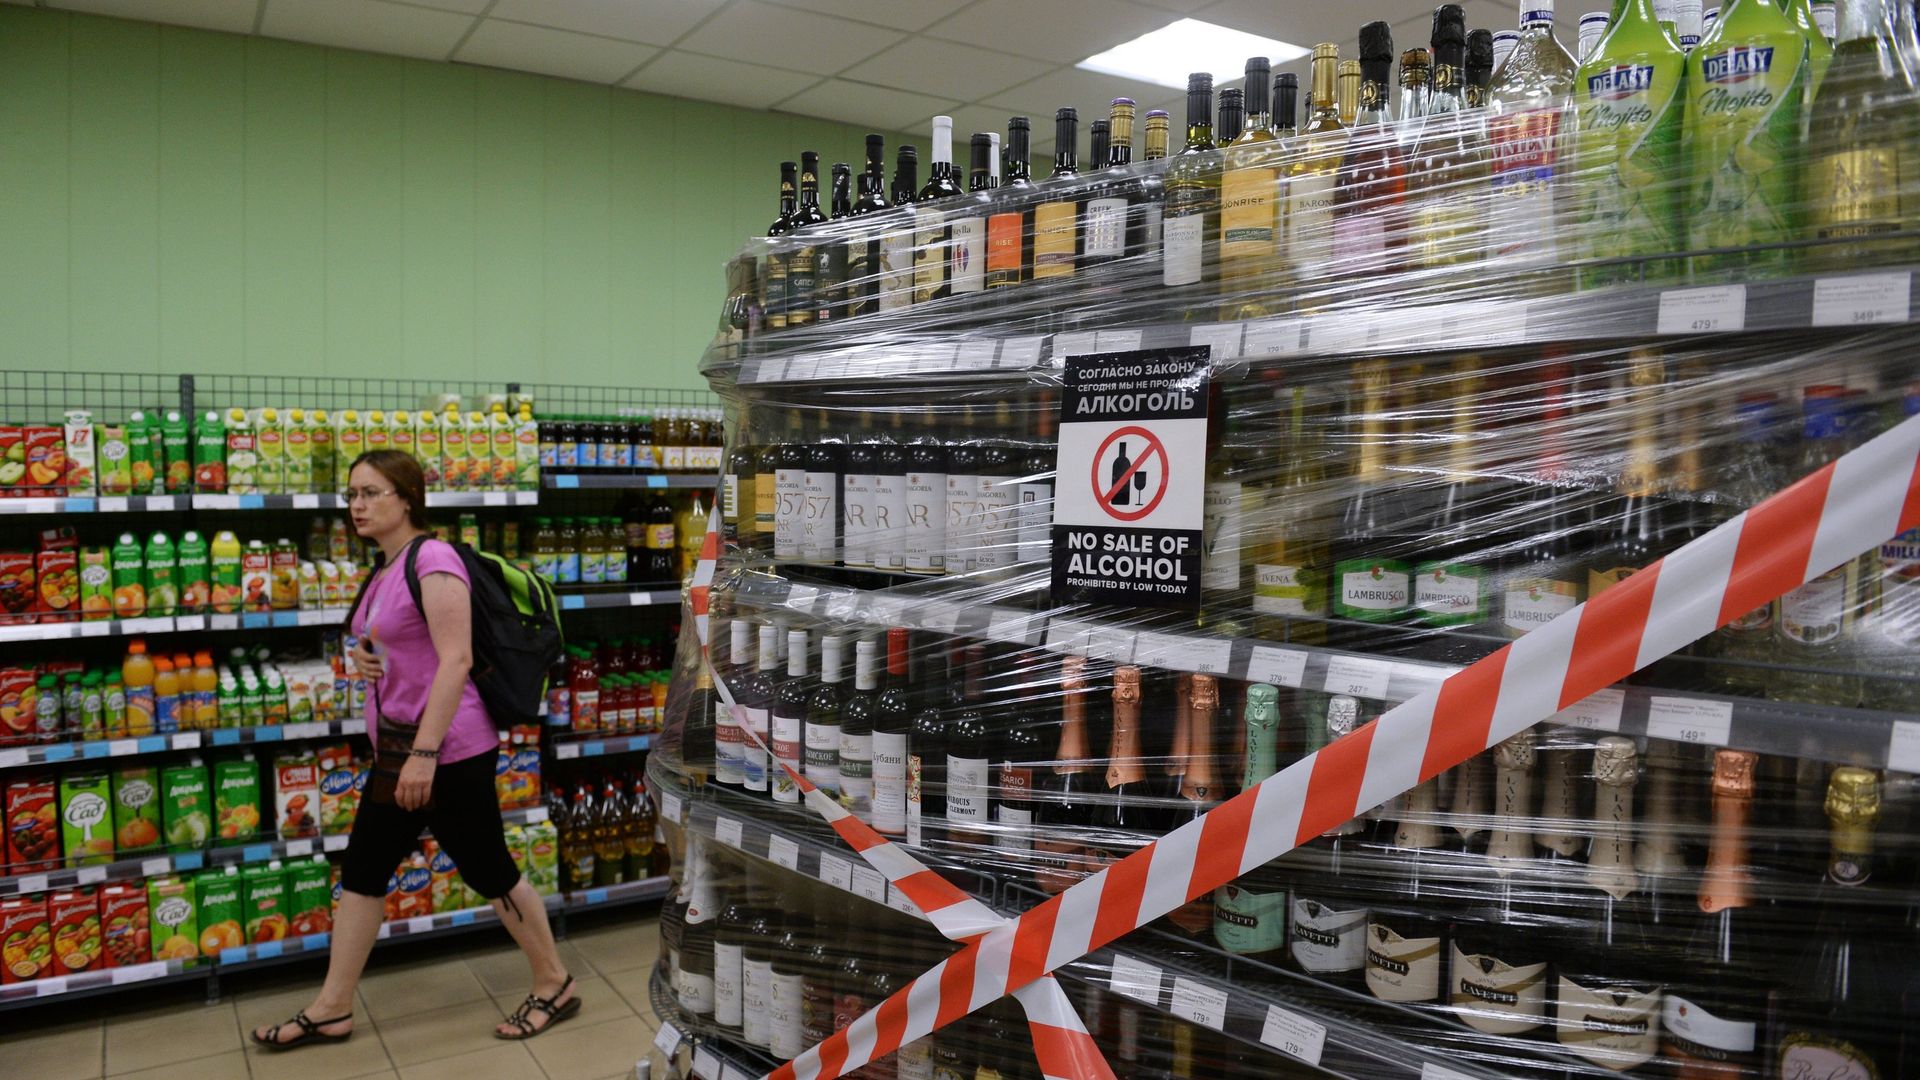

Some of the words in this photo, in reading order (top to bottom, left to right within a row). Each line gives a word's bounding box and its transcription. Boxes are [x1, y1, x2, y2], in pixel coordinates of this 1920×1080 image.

[1708, 50, 1769, 78] DELASY
[1592, 69, 1650, 92] DELASY
[1698, 87, 1773, 117] Mojito
[1584, 104, 1653, 132] Mojito
[1691, 319, 1711, 330] 479
[1078, 365, 1143, 380] СОГЛАСНО
[1145, 361, 1196, 375] ЗАКОНУ
[1077, 382, 1117, 392] СЕГОДНЯ
[1119, 381, 1134, 390] МЫ
[1136, 381, 1148, 389] НЕ
[1150, 379, 1194, 389] ПРОДА
[1076, 392, 1195, 415] АЛКОГОЛЬ
[1068, 531, 1097, 550] NO
[1103, 533, 1152, 553] SALE
[1159, 536, 1189, 555] OF
[1068, 553, 1188, 581] ALCOHOL
[1067, 577, 1117, 589] PROHIBITED
[1119, 580, 1131, 590] BY
[1133, 581, 1154, 592] LOW
[1156, 583, 1187, 594] TODAY
[1348, 589, 1405, 601] LAMBRUSCO
[1417, 591, 1470, 605] LAMBRUSCO
[1294, 923, 1336, 944] LAVETTI
[1193, 1011, 1206, 1023] 179
[1284, 1041, 1299, 1055] 179
